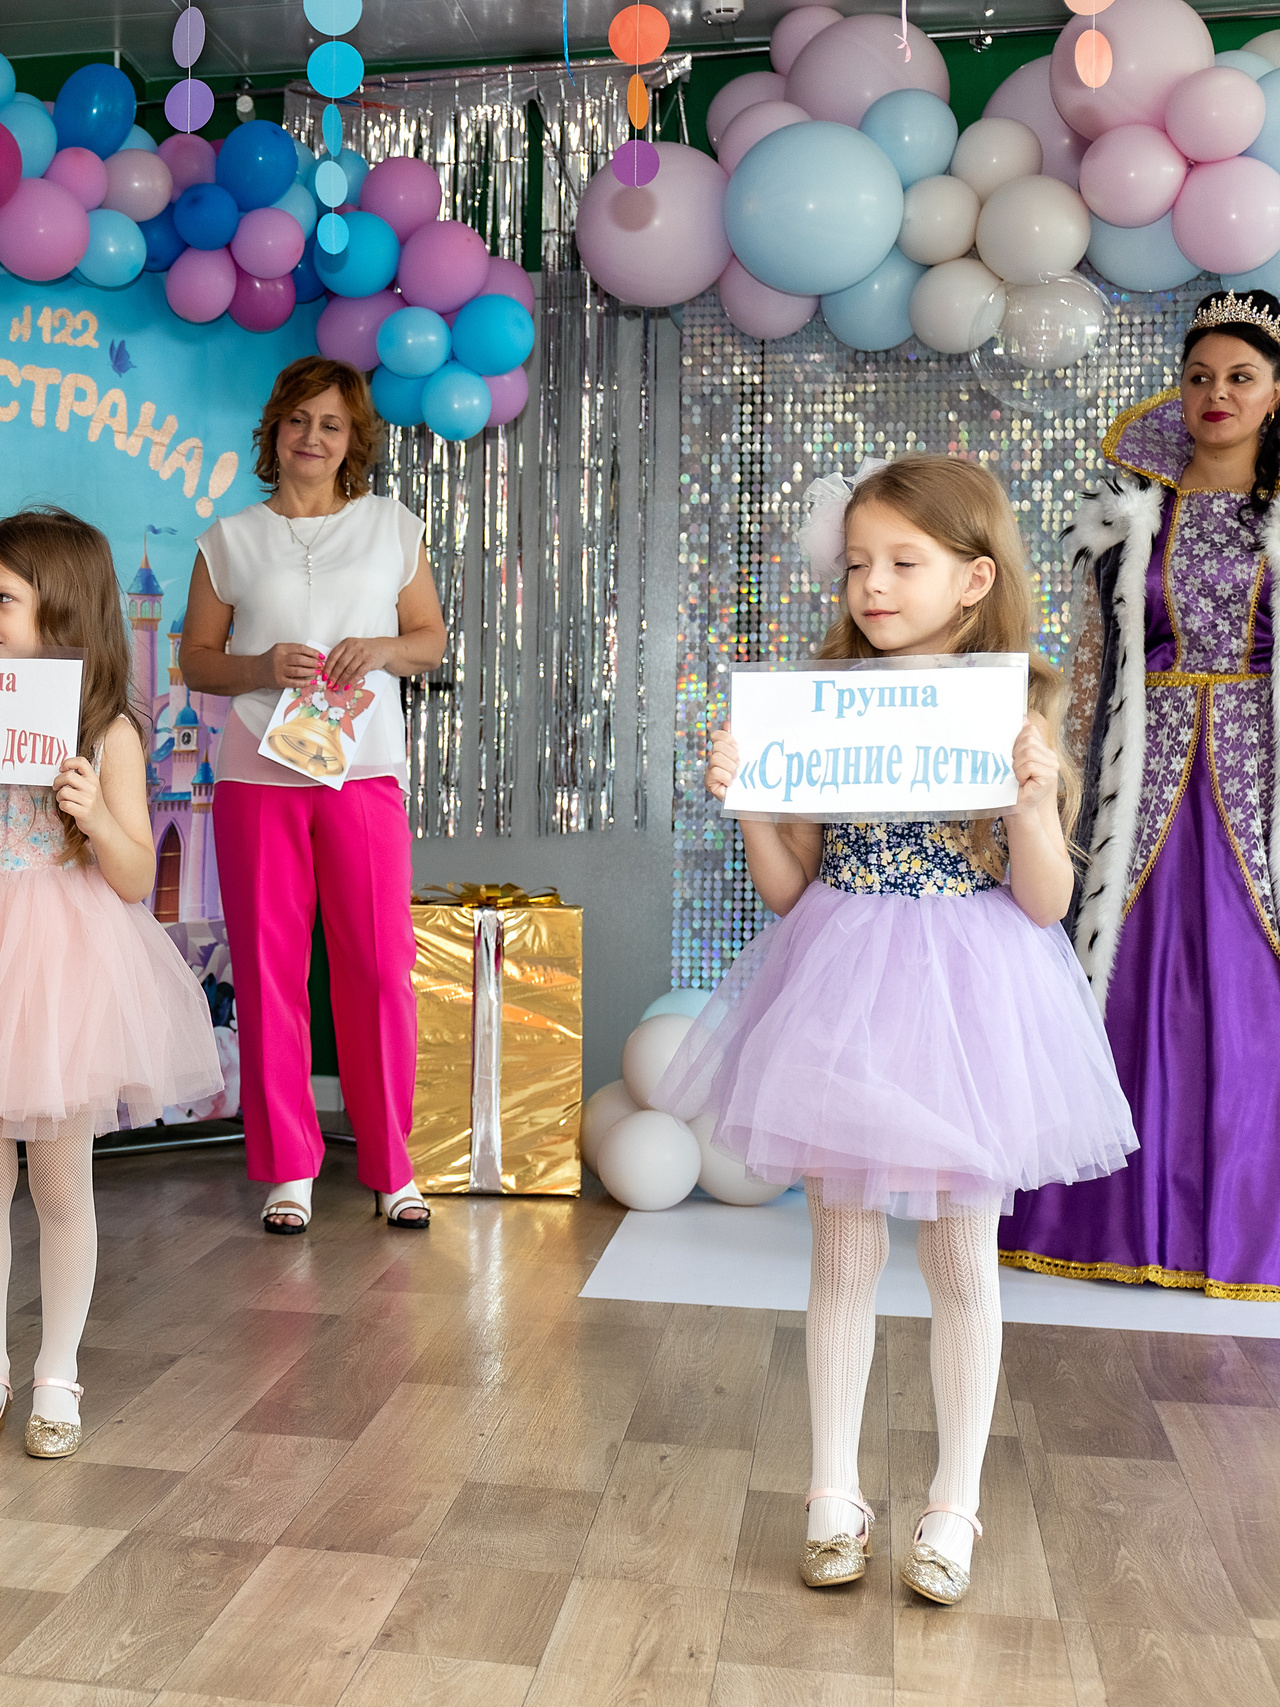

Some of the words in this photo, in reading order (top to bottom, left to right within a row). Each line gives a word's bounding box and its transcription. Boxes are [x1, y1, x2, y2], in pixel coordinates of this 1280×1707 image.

[811, 679, 939, 719] Группа
[1, 727, 69, 771] дети»
[739, 739, 903, 802] «Средние
[910, 745, 1011, 793] дети»
